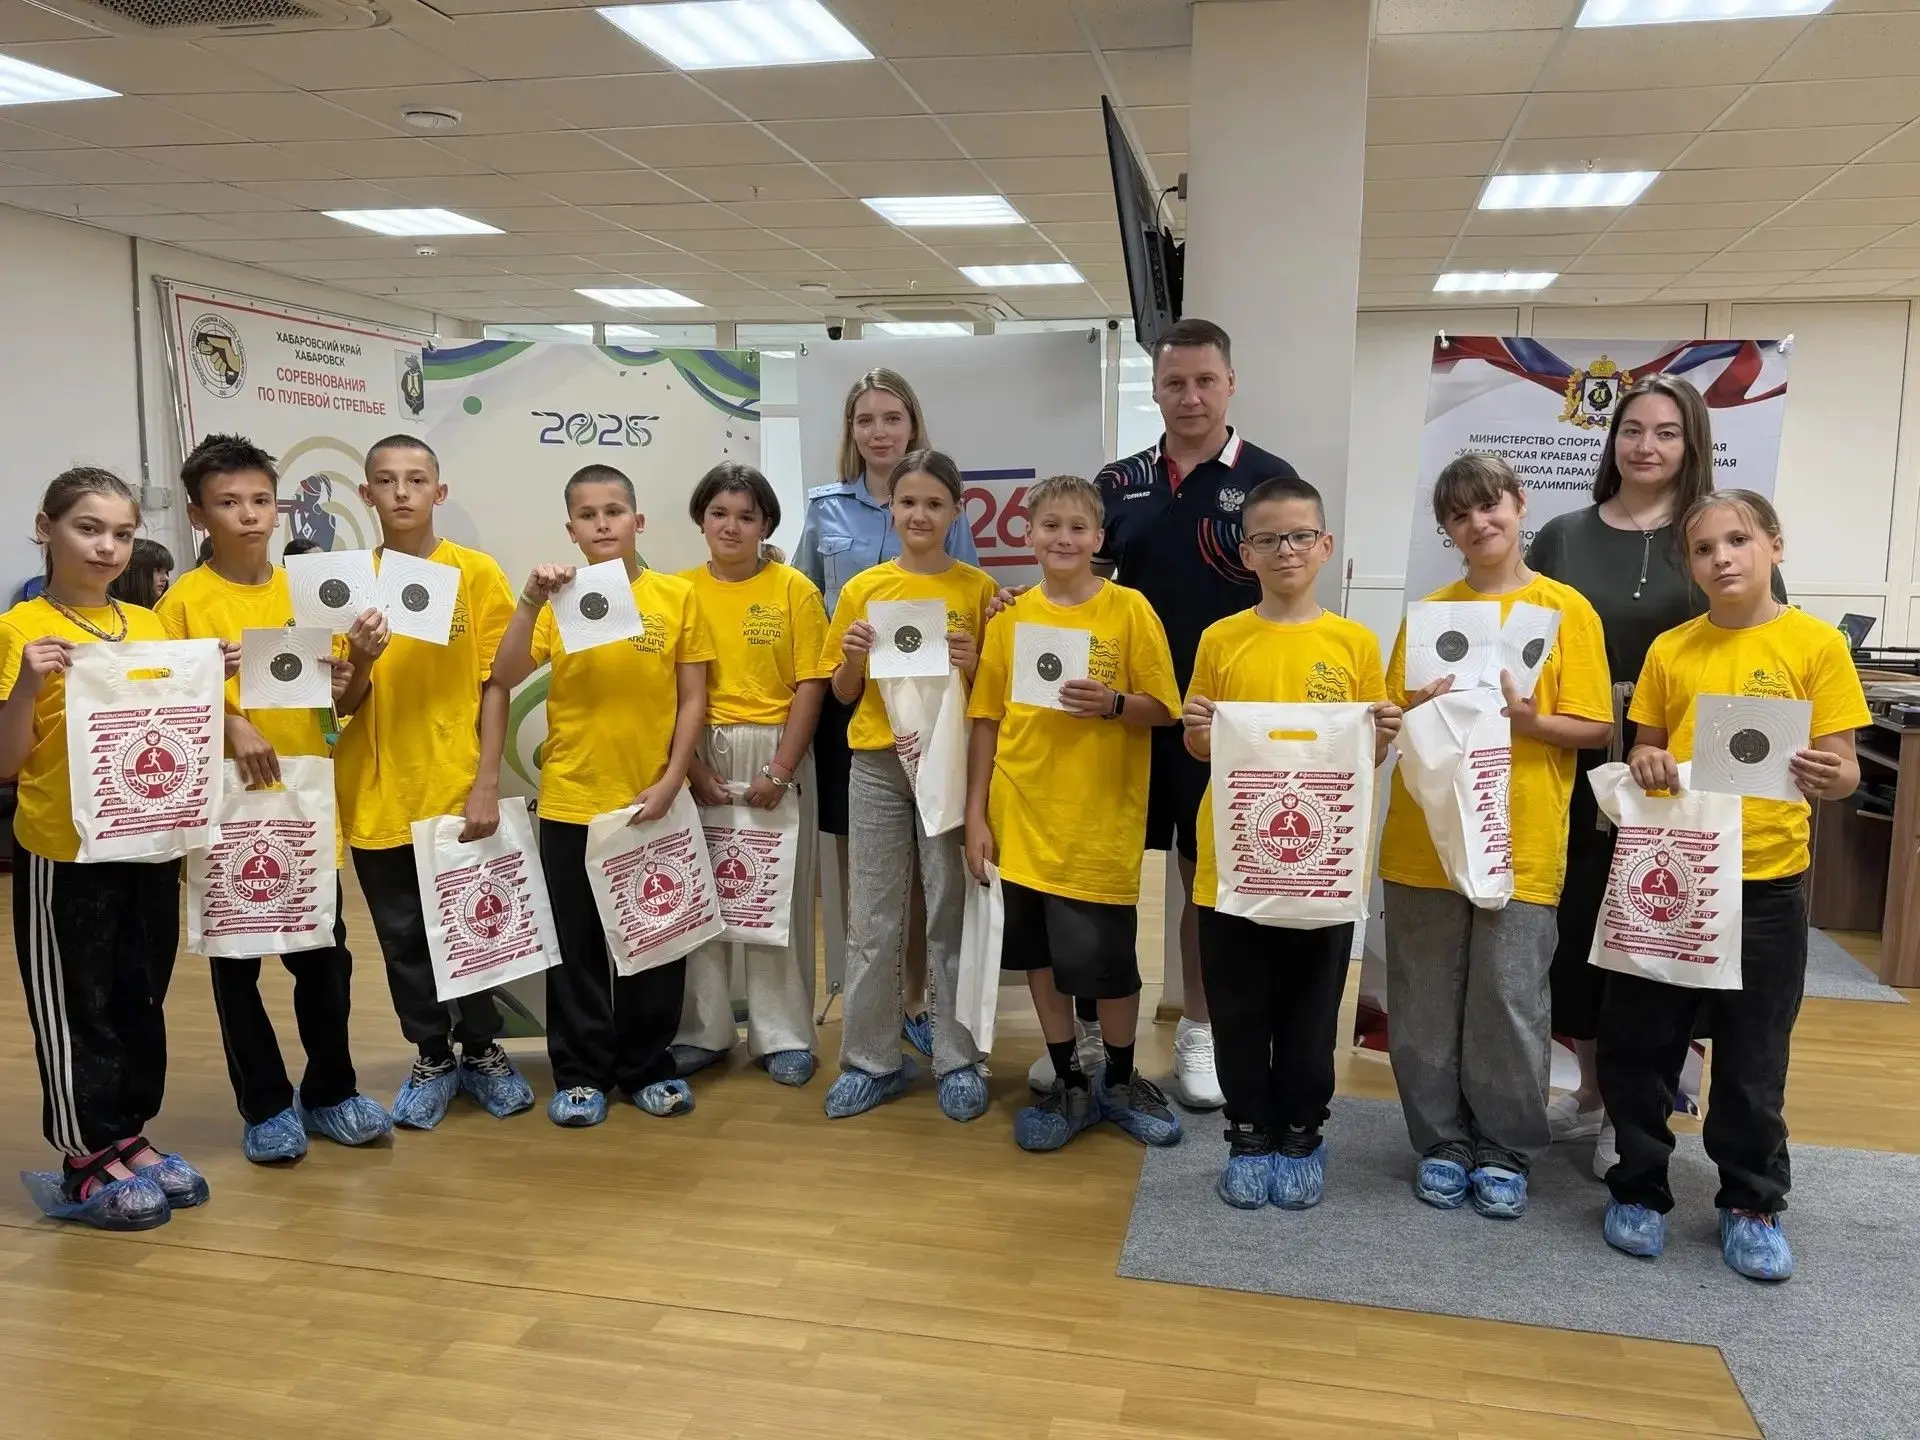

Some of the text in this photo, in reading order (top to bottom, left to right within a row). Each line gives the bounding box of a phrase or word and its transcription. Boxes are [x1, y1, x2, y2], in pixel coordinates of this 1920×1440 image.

[276, 331, 362, 356] ХАБАРОВСКИЙ КРАЙ
[295, 349, 346, 367] ХАБАРОВСК
[276, 367, 366, 393] СОРЕВНОВАНИЯ
[257, 386, 386, 417] ПО ПУЛЕВОЙ СТРЕЛЬБЕ
[1469, 434, 1555, 448] МИНИСТЕРСТВО
[1557, 437, 1602, 448] СПОРТА
[1540, 451, 1587, 462] КРАЕВАЯ
[1514, 465, 1600, 477] ШКОЛА ПАРАЛИ
[146, 772, 167, 783] ГТО
[1280, 838, 1301, 847] ГТО
[250, 879, 272, 888] ГТО
[653, 893, 670, 904] ГТО
[1651, 895, 1671, 906] ГТО
[484, 914, 498, 926] ГТО
